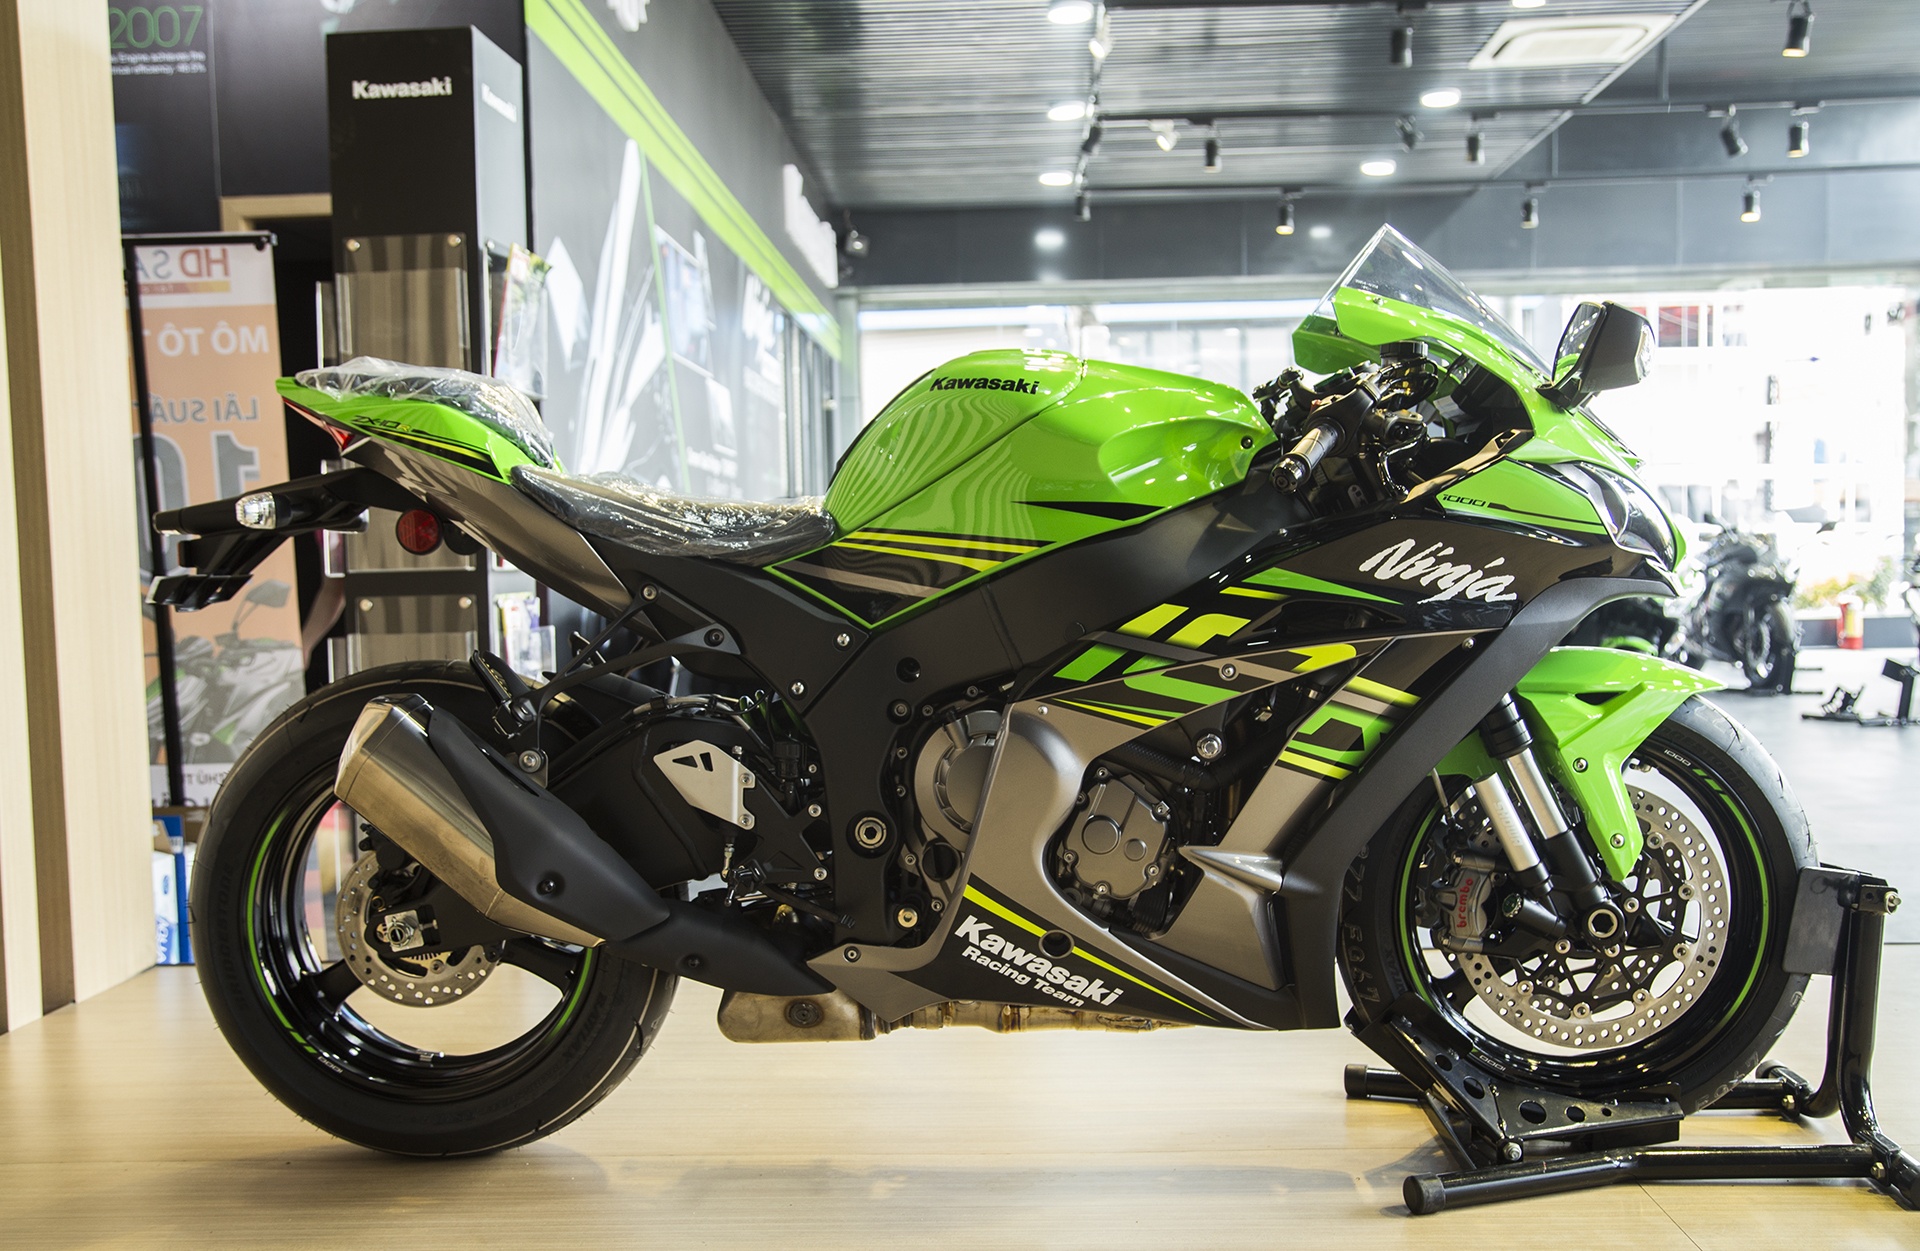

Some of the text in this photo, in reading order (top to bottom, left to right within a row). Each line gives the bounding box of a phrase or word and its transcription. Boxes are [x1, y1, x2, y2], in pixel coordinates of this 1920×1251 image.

[110, 6, 203, 48] 2007
[352, 76, 453, 99] Kawasaki
[929, 376, 1040, 395] Kawasaki
[1442, 493, 1486, 507] 1000
[1358, 538, 1518, 605] Ninja
[1664, 749, 1691, 767] 1000
[1456, 877, 1473, 929] brembo
[954, 914, 1124, 1006] Kawasaki
[961, 945, 1085, 1008] Racing Team
